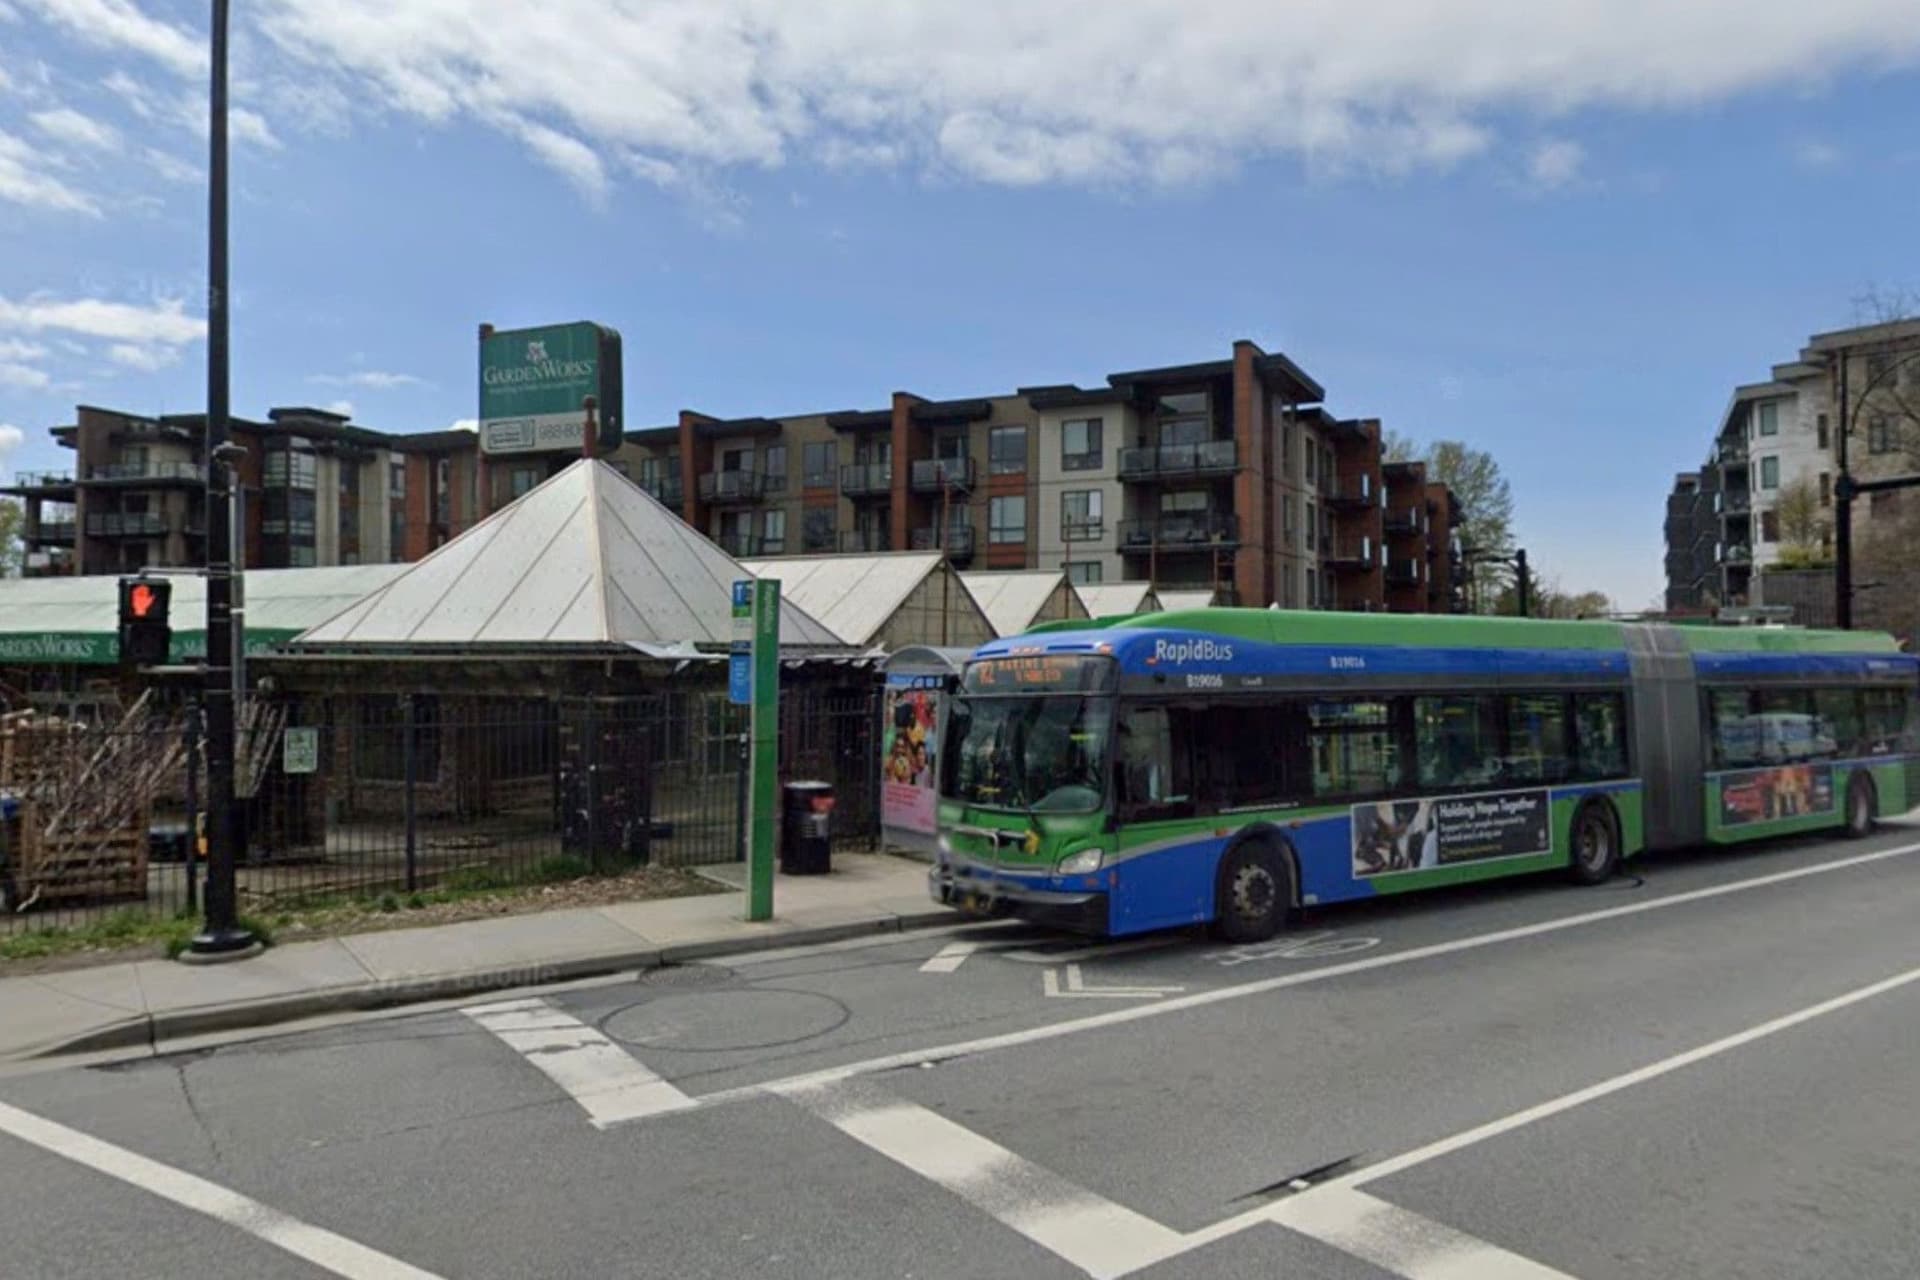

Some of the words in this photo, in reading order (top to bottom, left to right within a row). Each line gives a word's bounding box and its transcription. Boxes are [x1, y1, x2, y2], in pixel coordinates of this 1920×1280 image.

[1156, 639, 1234, 666] RapidBus
[1440, 803, 1475, 819] Holding
[1499, 797, 1537, 815] Together
